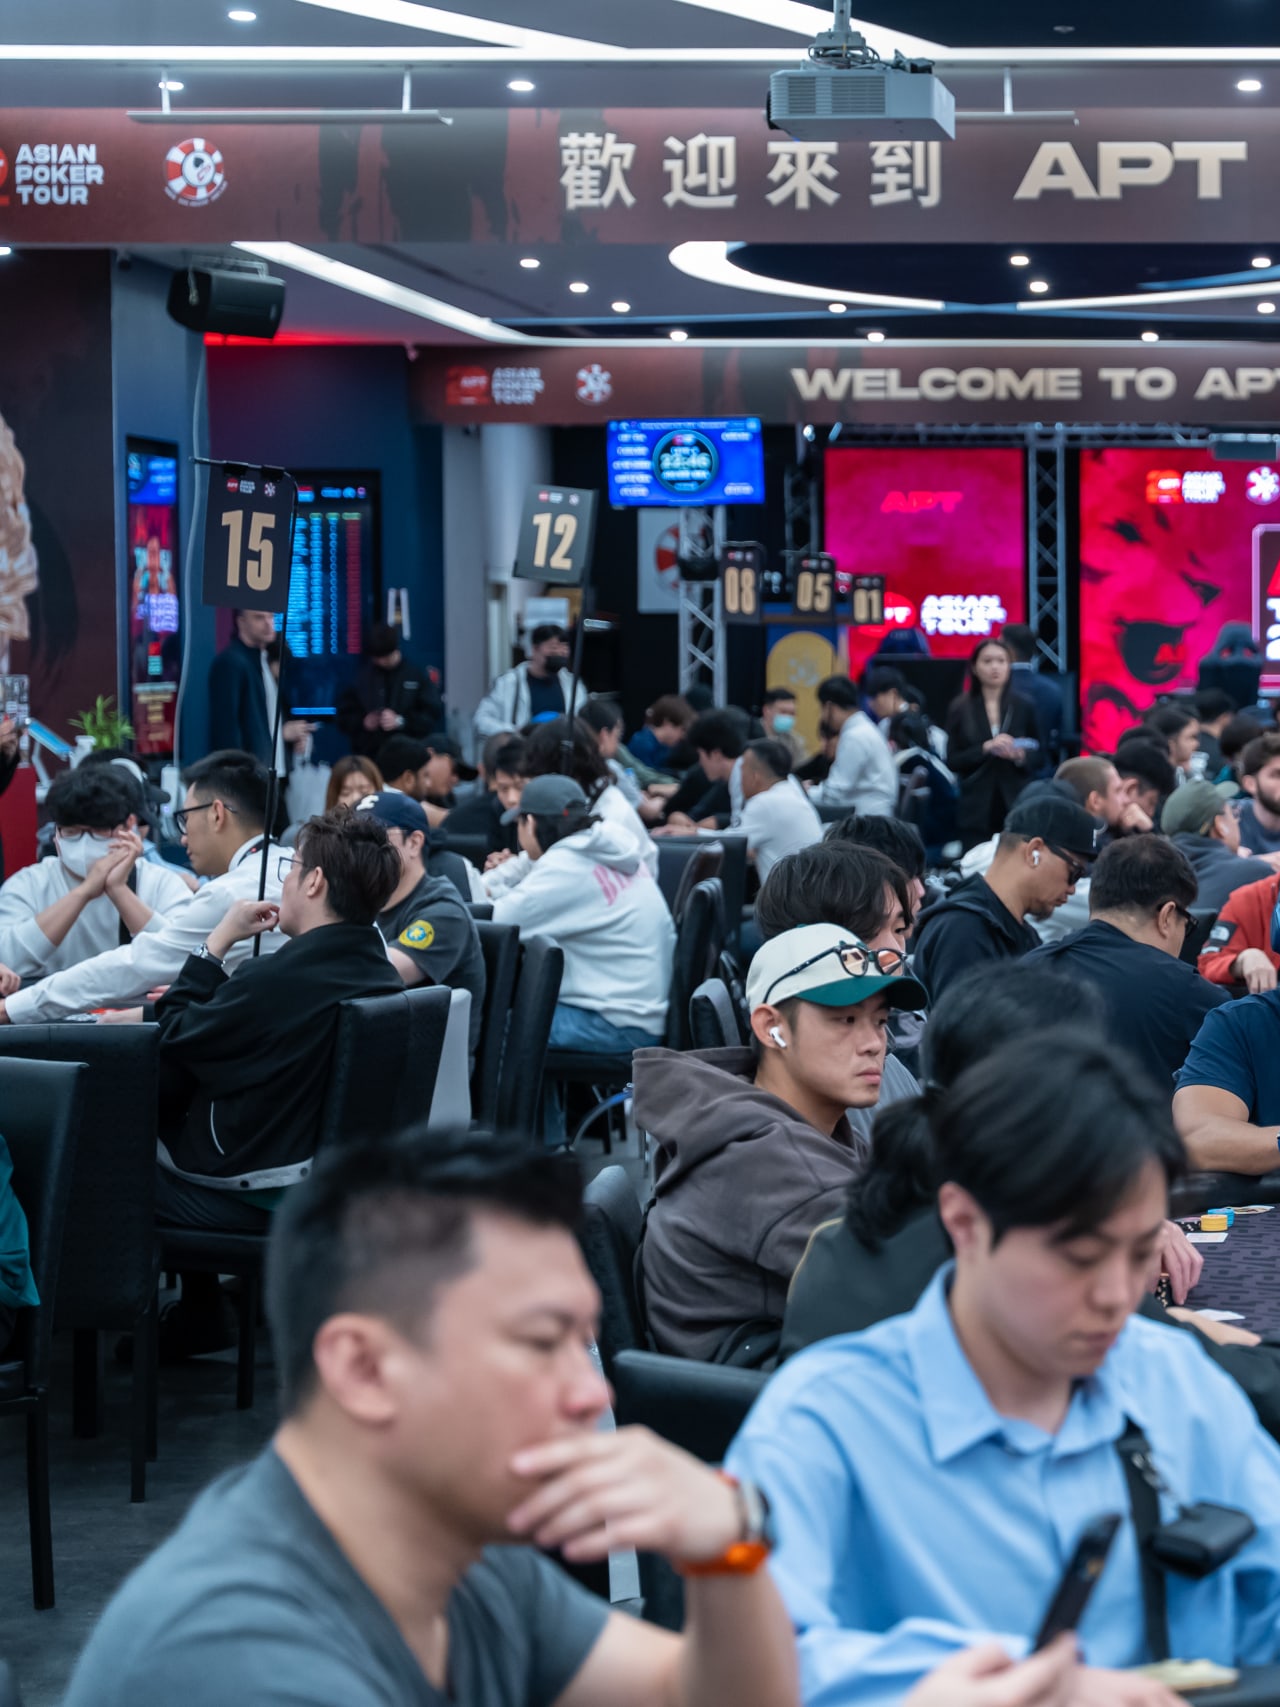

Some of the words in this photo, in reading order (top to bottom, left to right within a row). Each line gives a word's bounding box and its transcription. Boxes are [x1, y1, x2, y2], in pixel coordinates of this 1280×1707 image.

[16, 143, 97, 164] ASIAN
[559, 132, 942, 210] 歡迎來到
[1013, 141, 1247, 199] APT
[15, 164, 104, 184] POKER
[16, 184, 89, 205] TOUR
[790, 368, 1081, 400] WELCOME
[1098, 368, 1177, 400] TO
[880, 491, 963, 512] APT
[221, 509, 276, 591] 15
[532, 512, 577, 571] 12
[725, 566, 756, 615] 08
[797, 571, 832, 612] 05
[853, 588, 883, 624] 01
